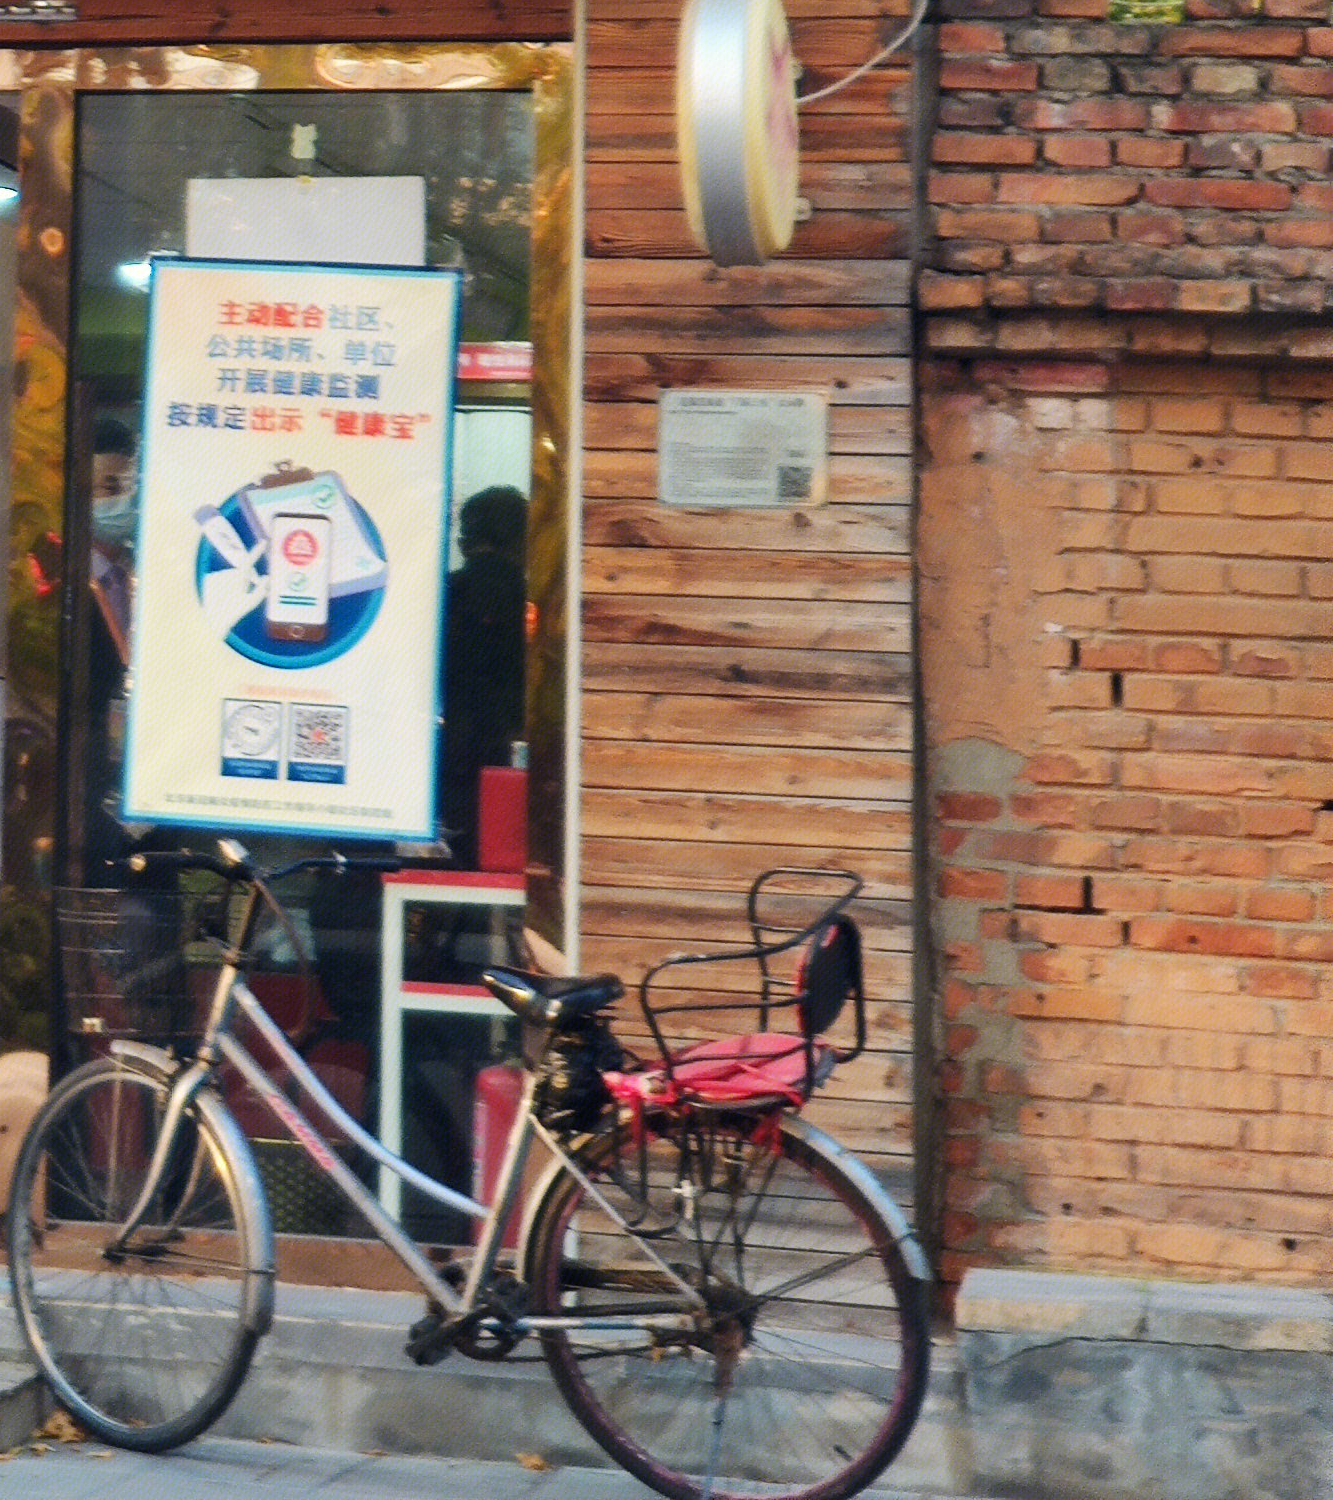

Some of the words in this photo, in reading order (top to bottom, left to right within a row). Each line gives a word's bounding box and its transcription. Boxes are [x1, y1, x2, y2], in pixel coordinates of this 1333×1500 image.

[217, 300, 393, 332] 主动配合社区、
[217, 367, 381, 400] 开展健康监测
